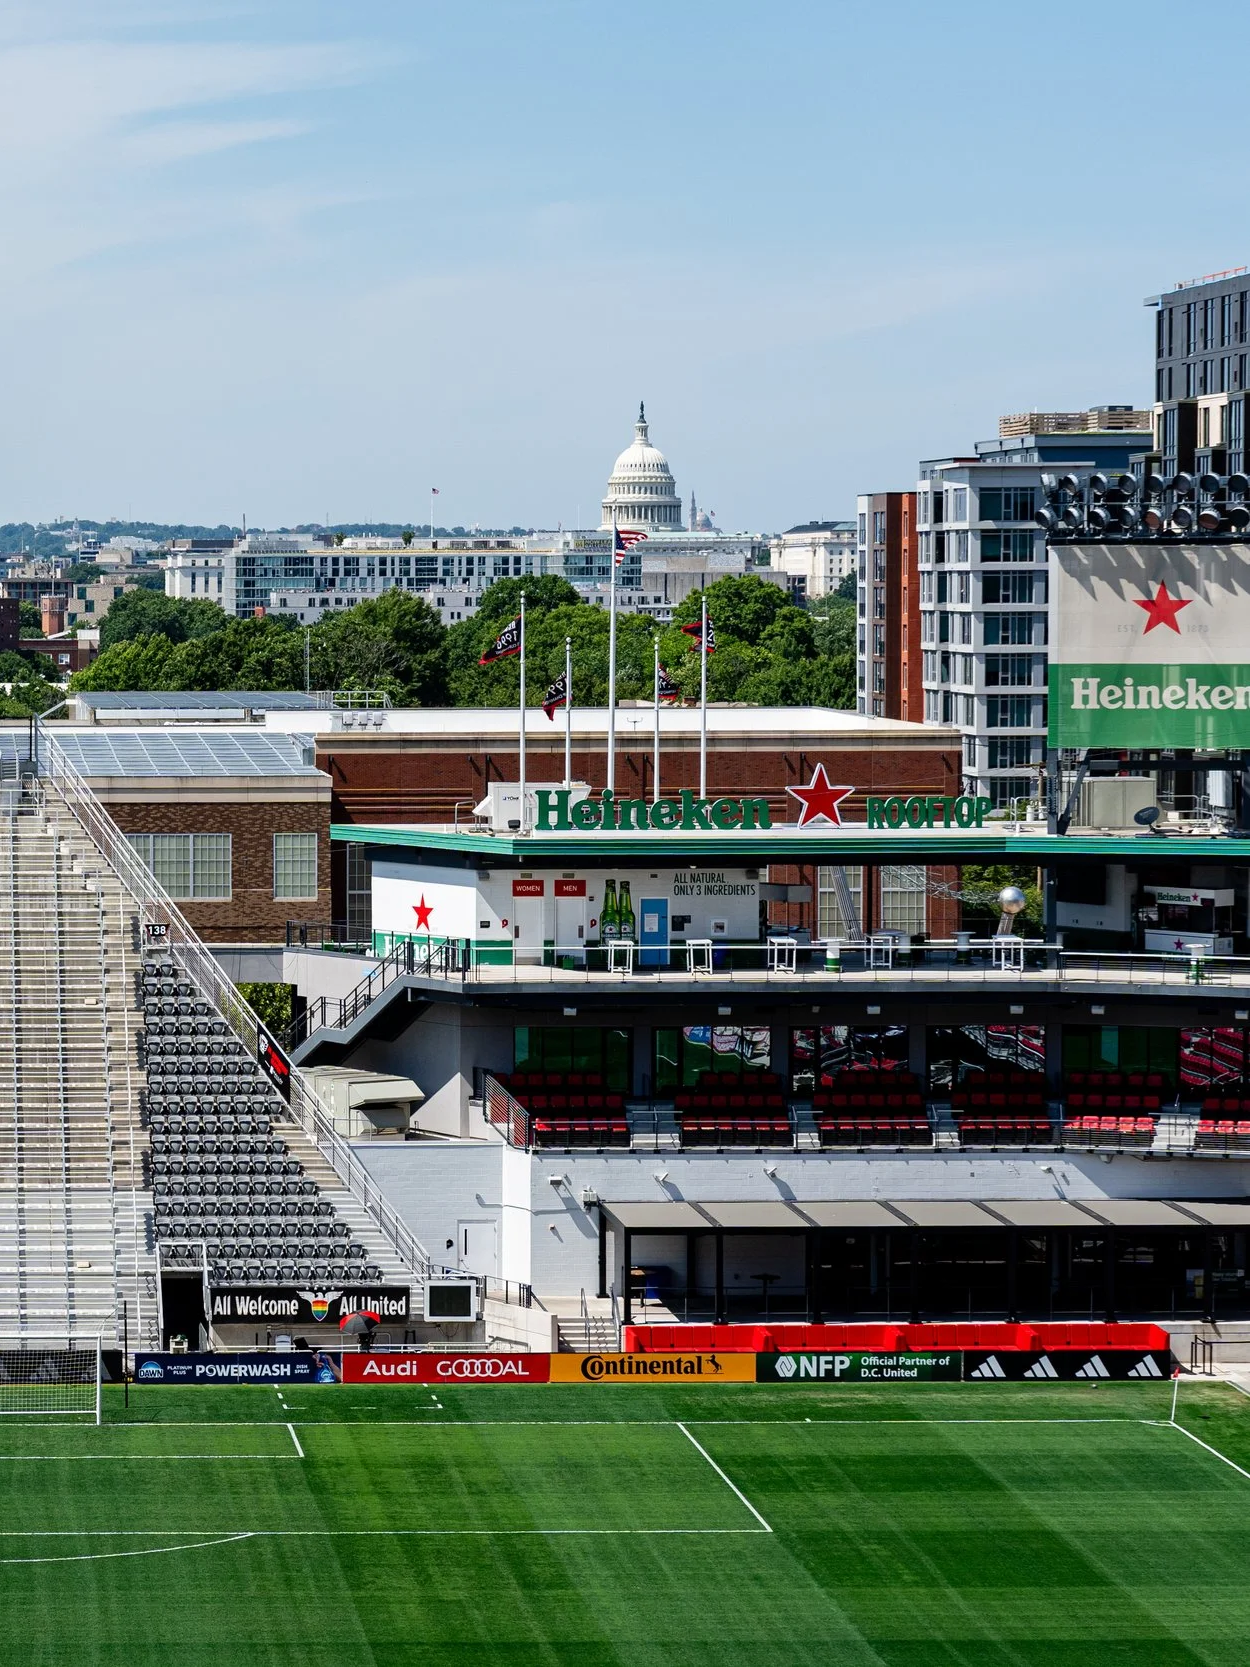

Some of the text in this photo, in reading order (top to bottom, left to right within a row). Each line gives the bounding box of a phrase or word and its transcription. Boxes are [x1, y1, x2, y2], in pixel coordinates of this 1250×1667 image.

[535, 788, 992, 830] Heineken ROOFTOP
[673, 872, 688, 884] ALL
[673, 884, 756, 896] ONLY 3 INGREDIENTS
[1157, 892, 1191, 903] Heineken
[148, 925, 166, 935] 138
[213, 1295, 406, 1315] All Welcome All United
[860, 1355, 950, 1367] Official Partner of
[138, 1368, 164, 1379] DAWN
[195, 1364, 291, 1377] POWERWASH
[362, 1360, 417, 1377] Audi
[581, 1355, 703, 1381] Continental
[860, 1367, 918, 1378] D.C. United
